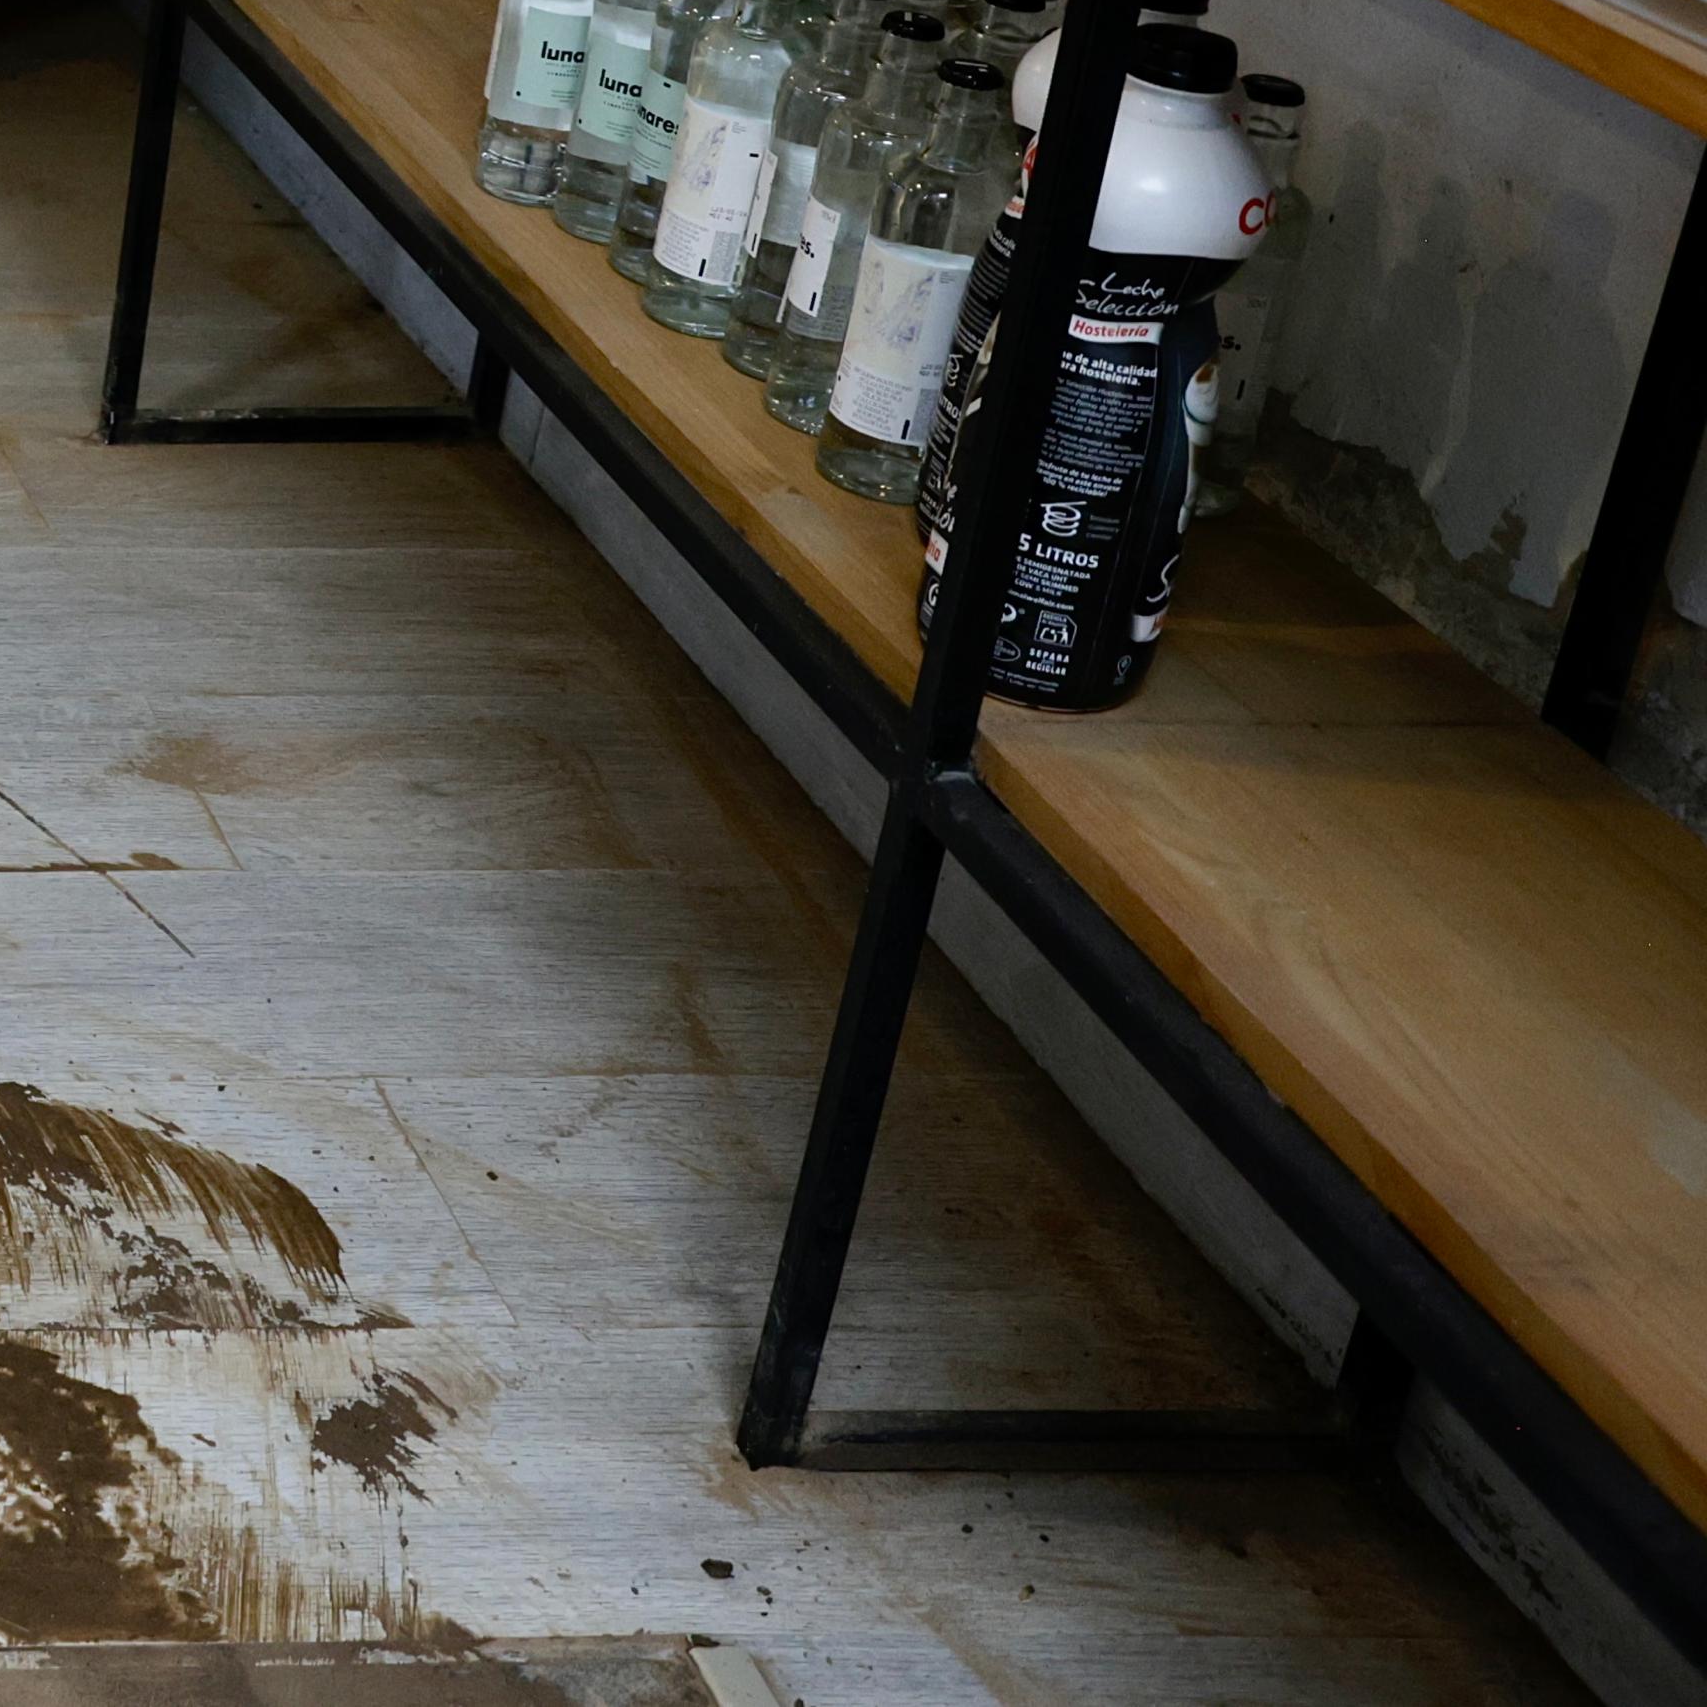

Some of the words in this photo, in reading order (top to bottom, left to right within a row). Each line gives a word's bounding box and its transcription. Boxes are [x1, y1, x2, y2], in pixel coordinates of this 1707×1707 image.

[540, 40, 585, 64] luna
[599, 68, 643, 98] luna
[1100, 271, 1165, 299] Leche
[1075, 279, 1179, 317] Selección
[1072, 319, 1149, 338] Hostelería
[1060, 359, 1076, 373] ara
[1074, 353, 1089, 366] de
[1091, 358, 1114, 372] alta
[1116, 364, 1158, 379] calidad
[1035, 543, 1099, 568] LITROS
[1023, 558, 1091, 579] SEMIDESNATADA
[1028, 566, 1049, 578] VACA
[1041, 577, 1079, 593] SKIMMED
[1029, 648, 1069, 663] SEPARA
[1026, 660, 1066, 676] RECICLAR
